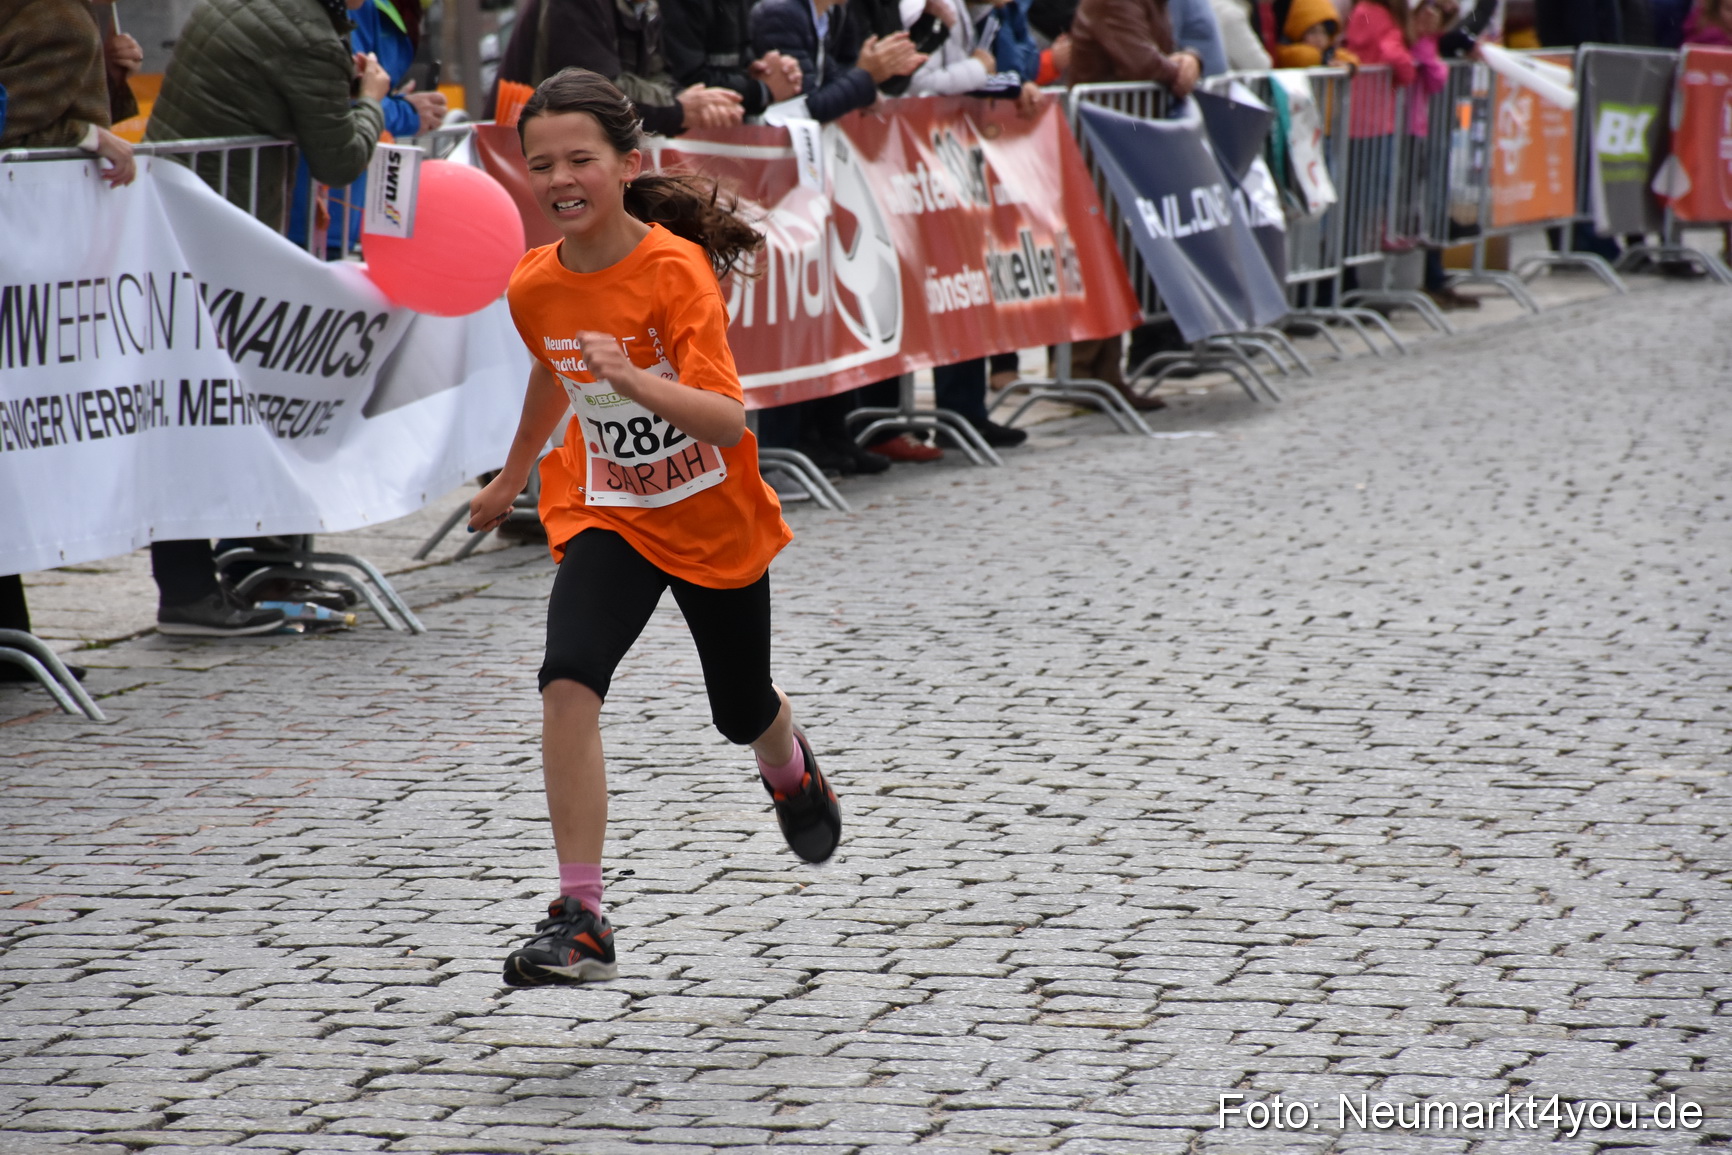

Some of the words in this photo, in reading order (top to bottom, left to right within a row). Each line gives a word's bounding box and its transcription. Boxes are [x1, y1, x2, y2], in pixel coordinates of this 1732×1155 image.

[385, 150, 401, 202] swn
[0, 396, 67, 451] ENIGER
[586, 413, 688, 459] 7282
[606, 442, 706, 495] SARAH
